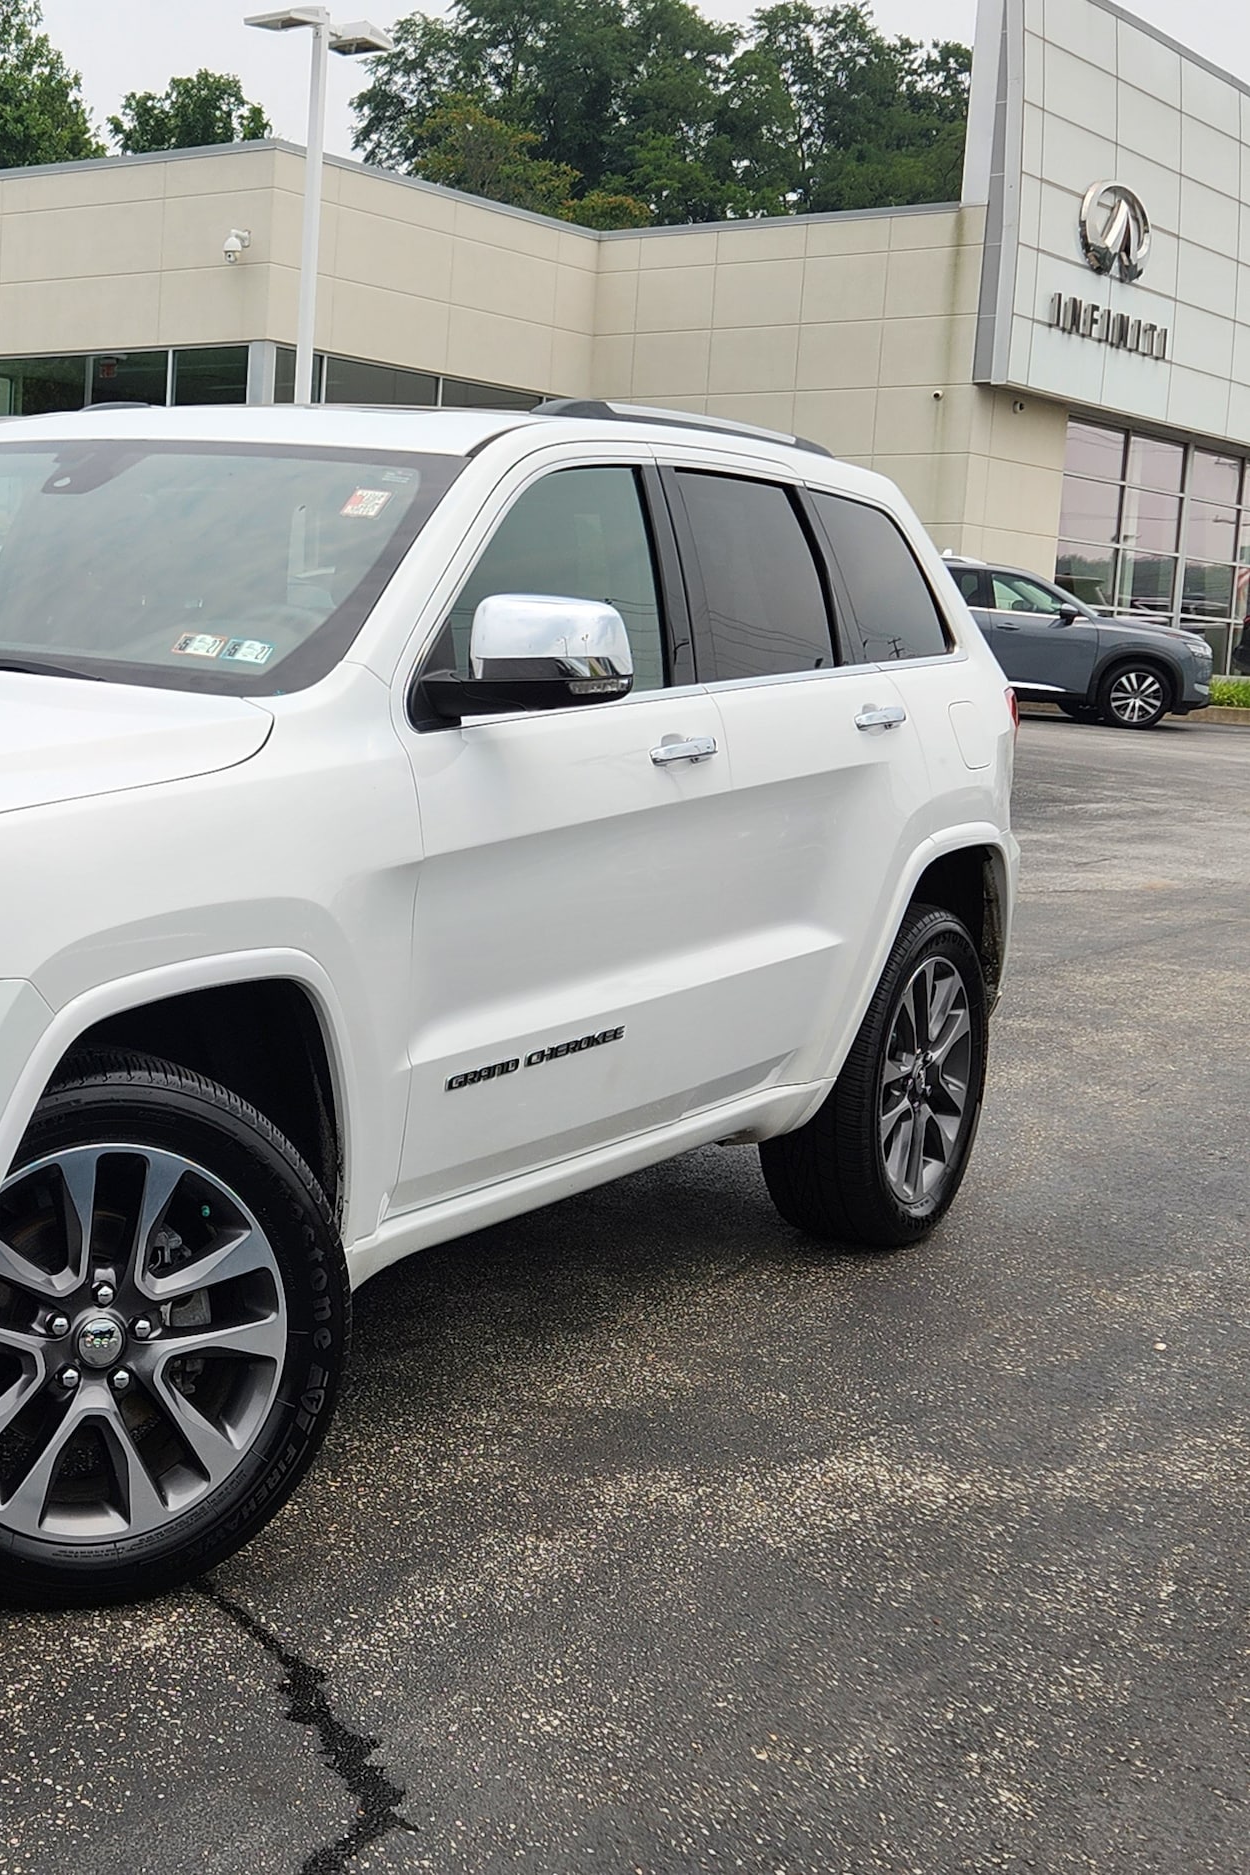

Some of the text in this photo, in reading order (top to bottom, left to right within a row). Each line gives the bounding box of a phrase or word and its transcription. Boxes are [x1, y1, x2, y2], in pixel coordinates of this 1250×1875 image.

[1050, 292, 1168, 360] INFINITI
[444, 1024, 626, 1092] GRAND CHEROKEE
